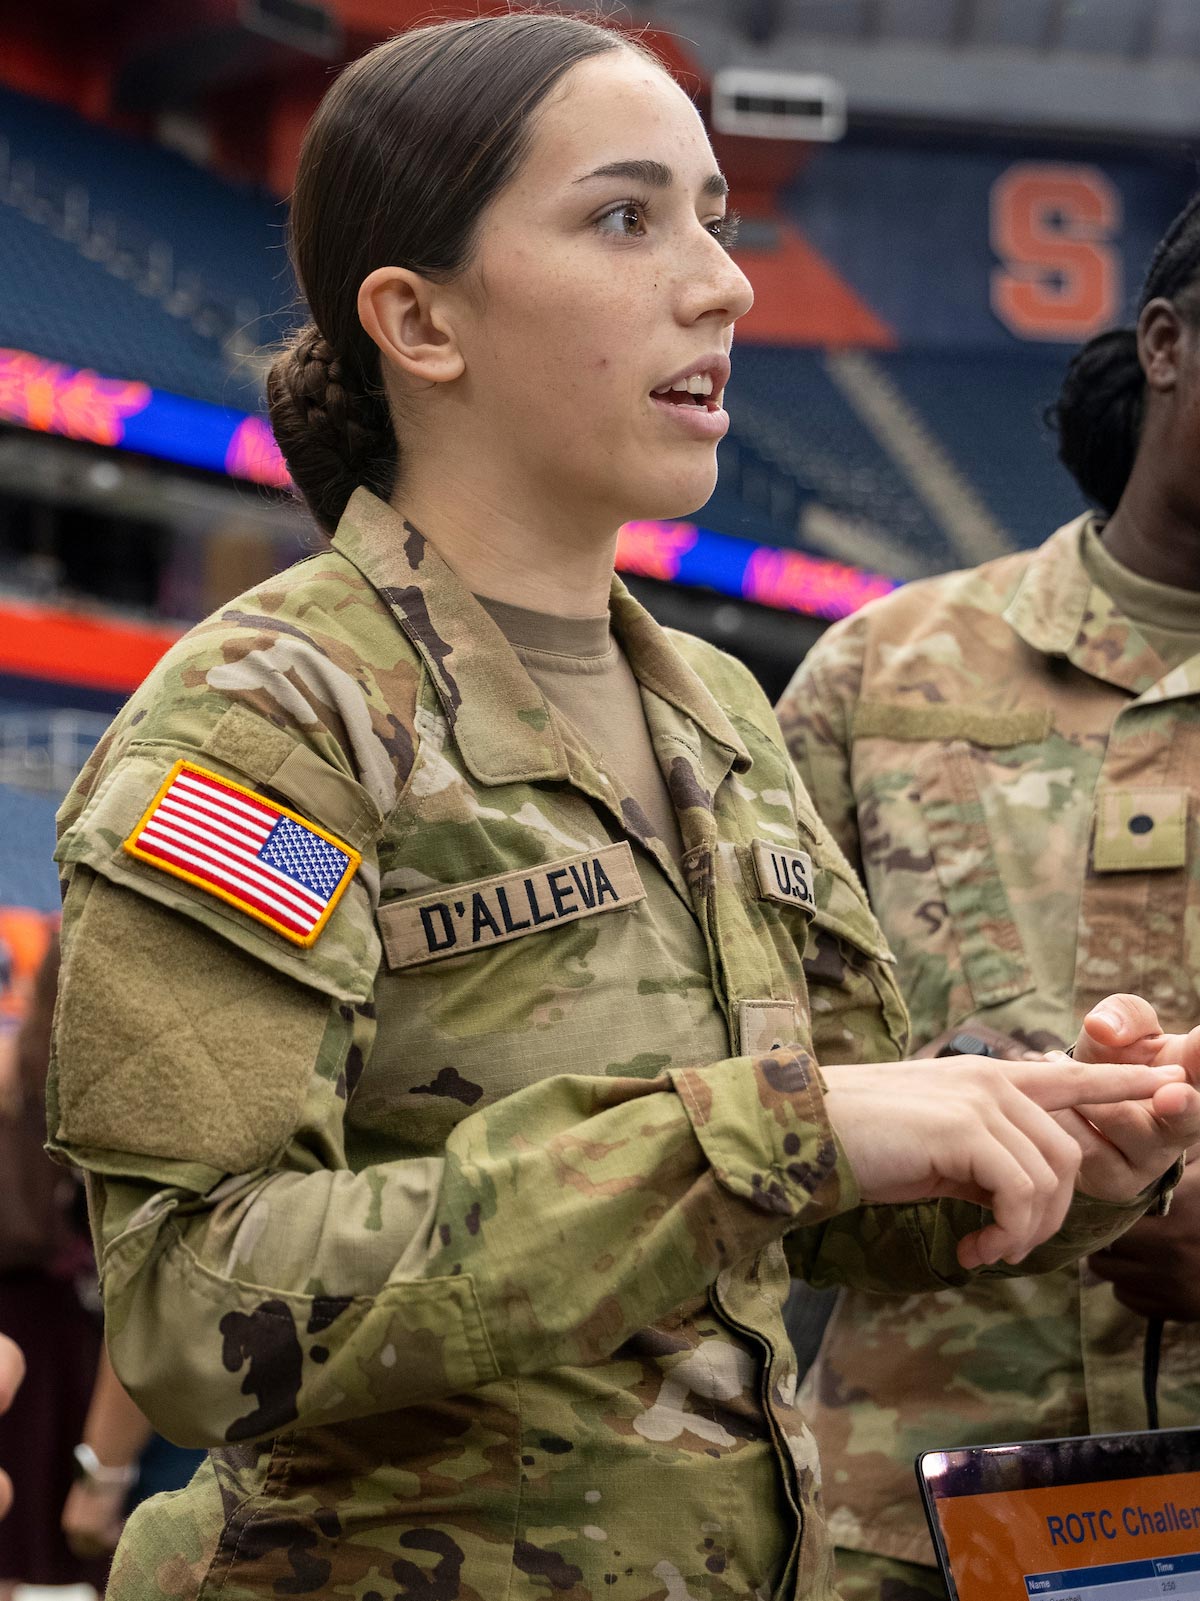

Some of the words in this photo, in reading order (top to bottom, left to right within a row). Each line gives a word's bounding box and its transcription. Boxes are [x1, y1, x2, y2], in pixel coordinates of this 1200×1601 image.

[988, 162, 1126, 344] S
[771, 853, 813, 904] U.S.
[419, 858, 620, 953] D'ALLEVA
[1047, 1509, 1117, 1546] ROTC
[1028, 1579, 1051, 1590] Name
[1156, 1562, 1175, 1573] Time
